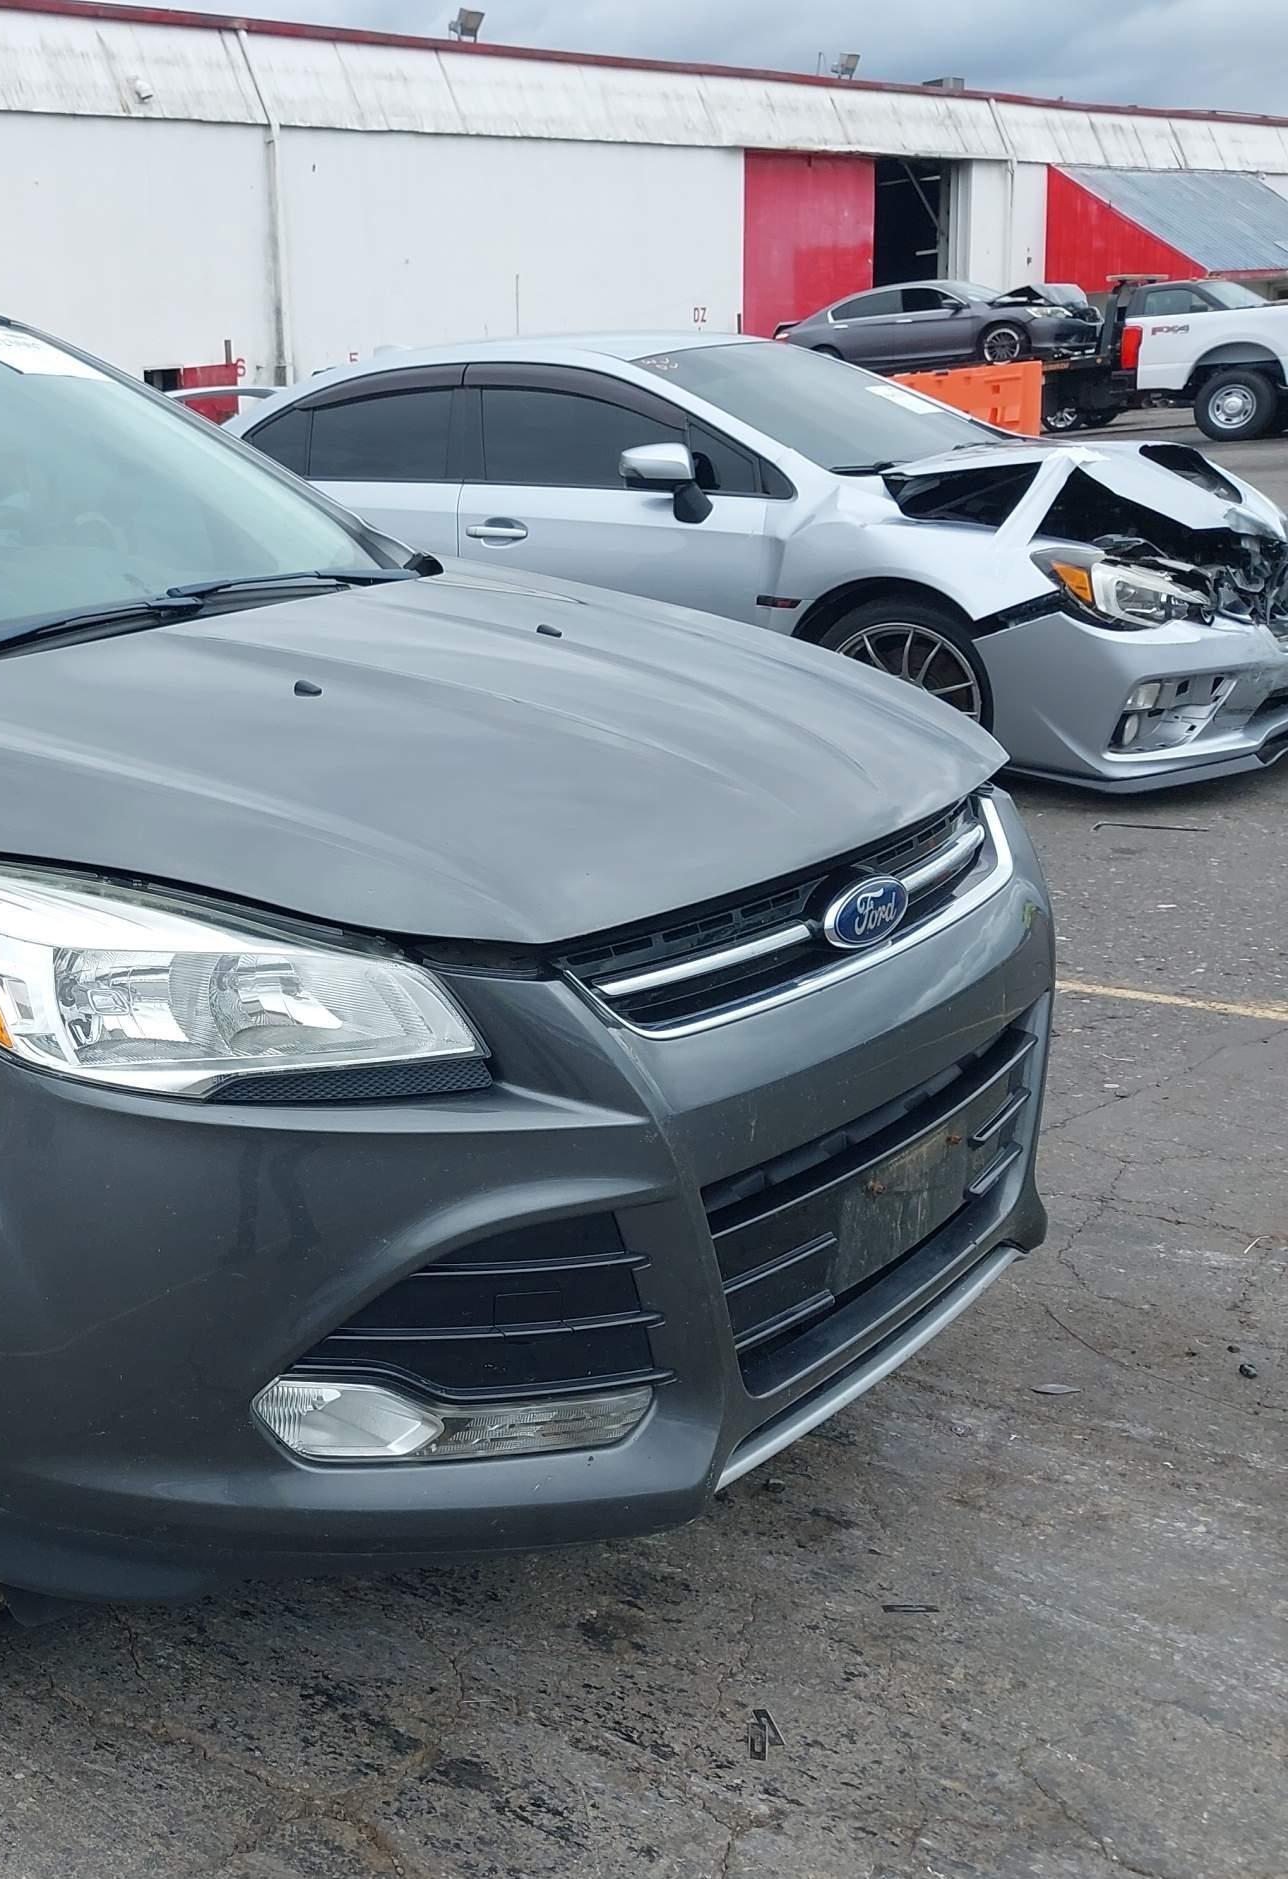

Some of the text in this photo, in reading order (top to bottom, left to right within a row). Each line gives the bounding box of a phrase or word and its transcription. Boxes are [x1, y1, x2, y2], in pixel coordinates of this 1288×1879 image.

[1151, 325, 1189, 335] FX4
[236, 358, 246, 377] 6
[854, 887, 898, 935] Ford
